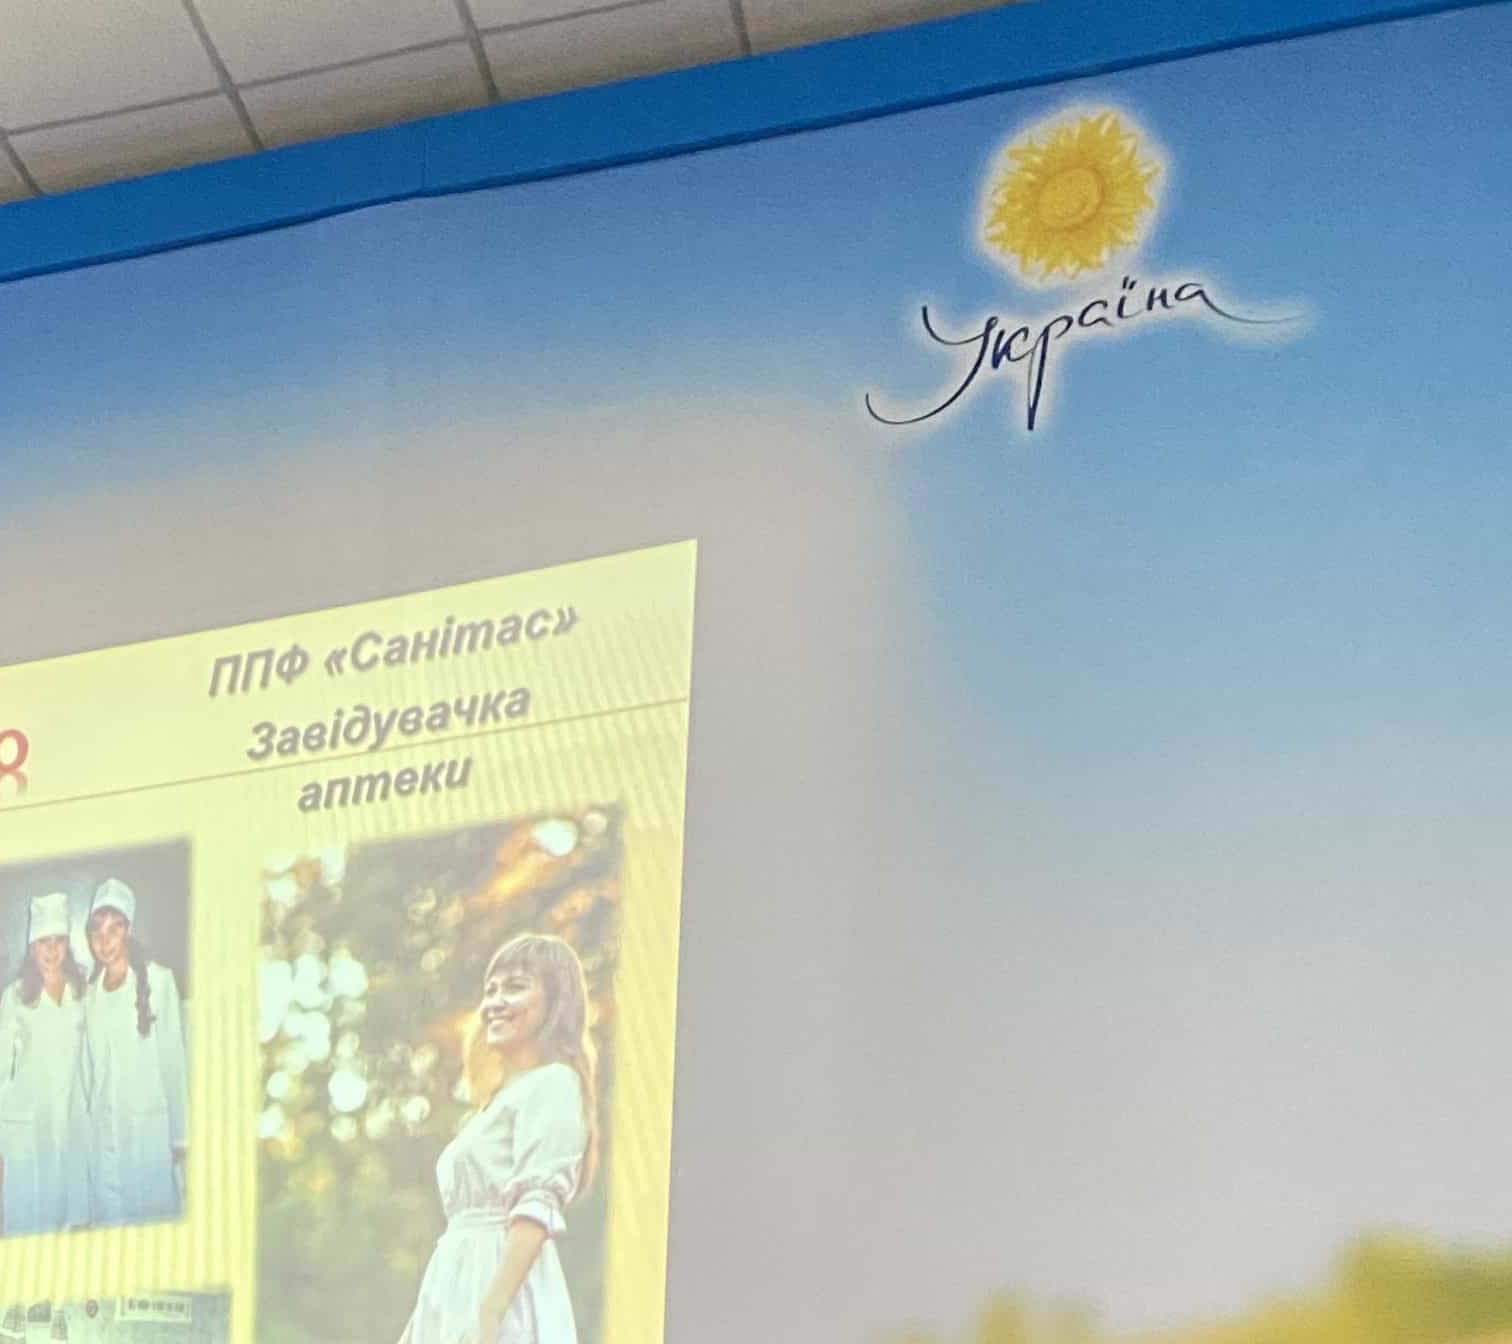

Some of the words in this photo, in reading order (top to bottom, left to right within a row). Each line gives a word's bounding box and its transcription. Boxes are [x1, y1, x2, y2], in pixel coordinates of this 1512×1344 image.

[867, 276, 1306, 430] Україна
[208, 644, 310, 698] ППФ
[324, 606, 579, 677] «Санітас»
[246, 687, 532, 762] Завідувачка
[297, 757, 473, 814] аптеки
